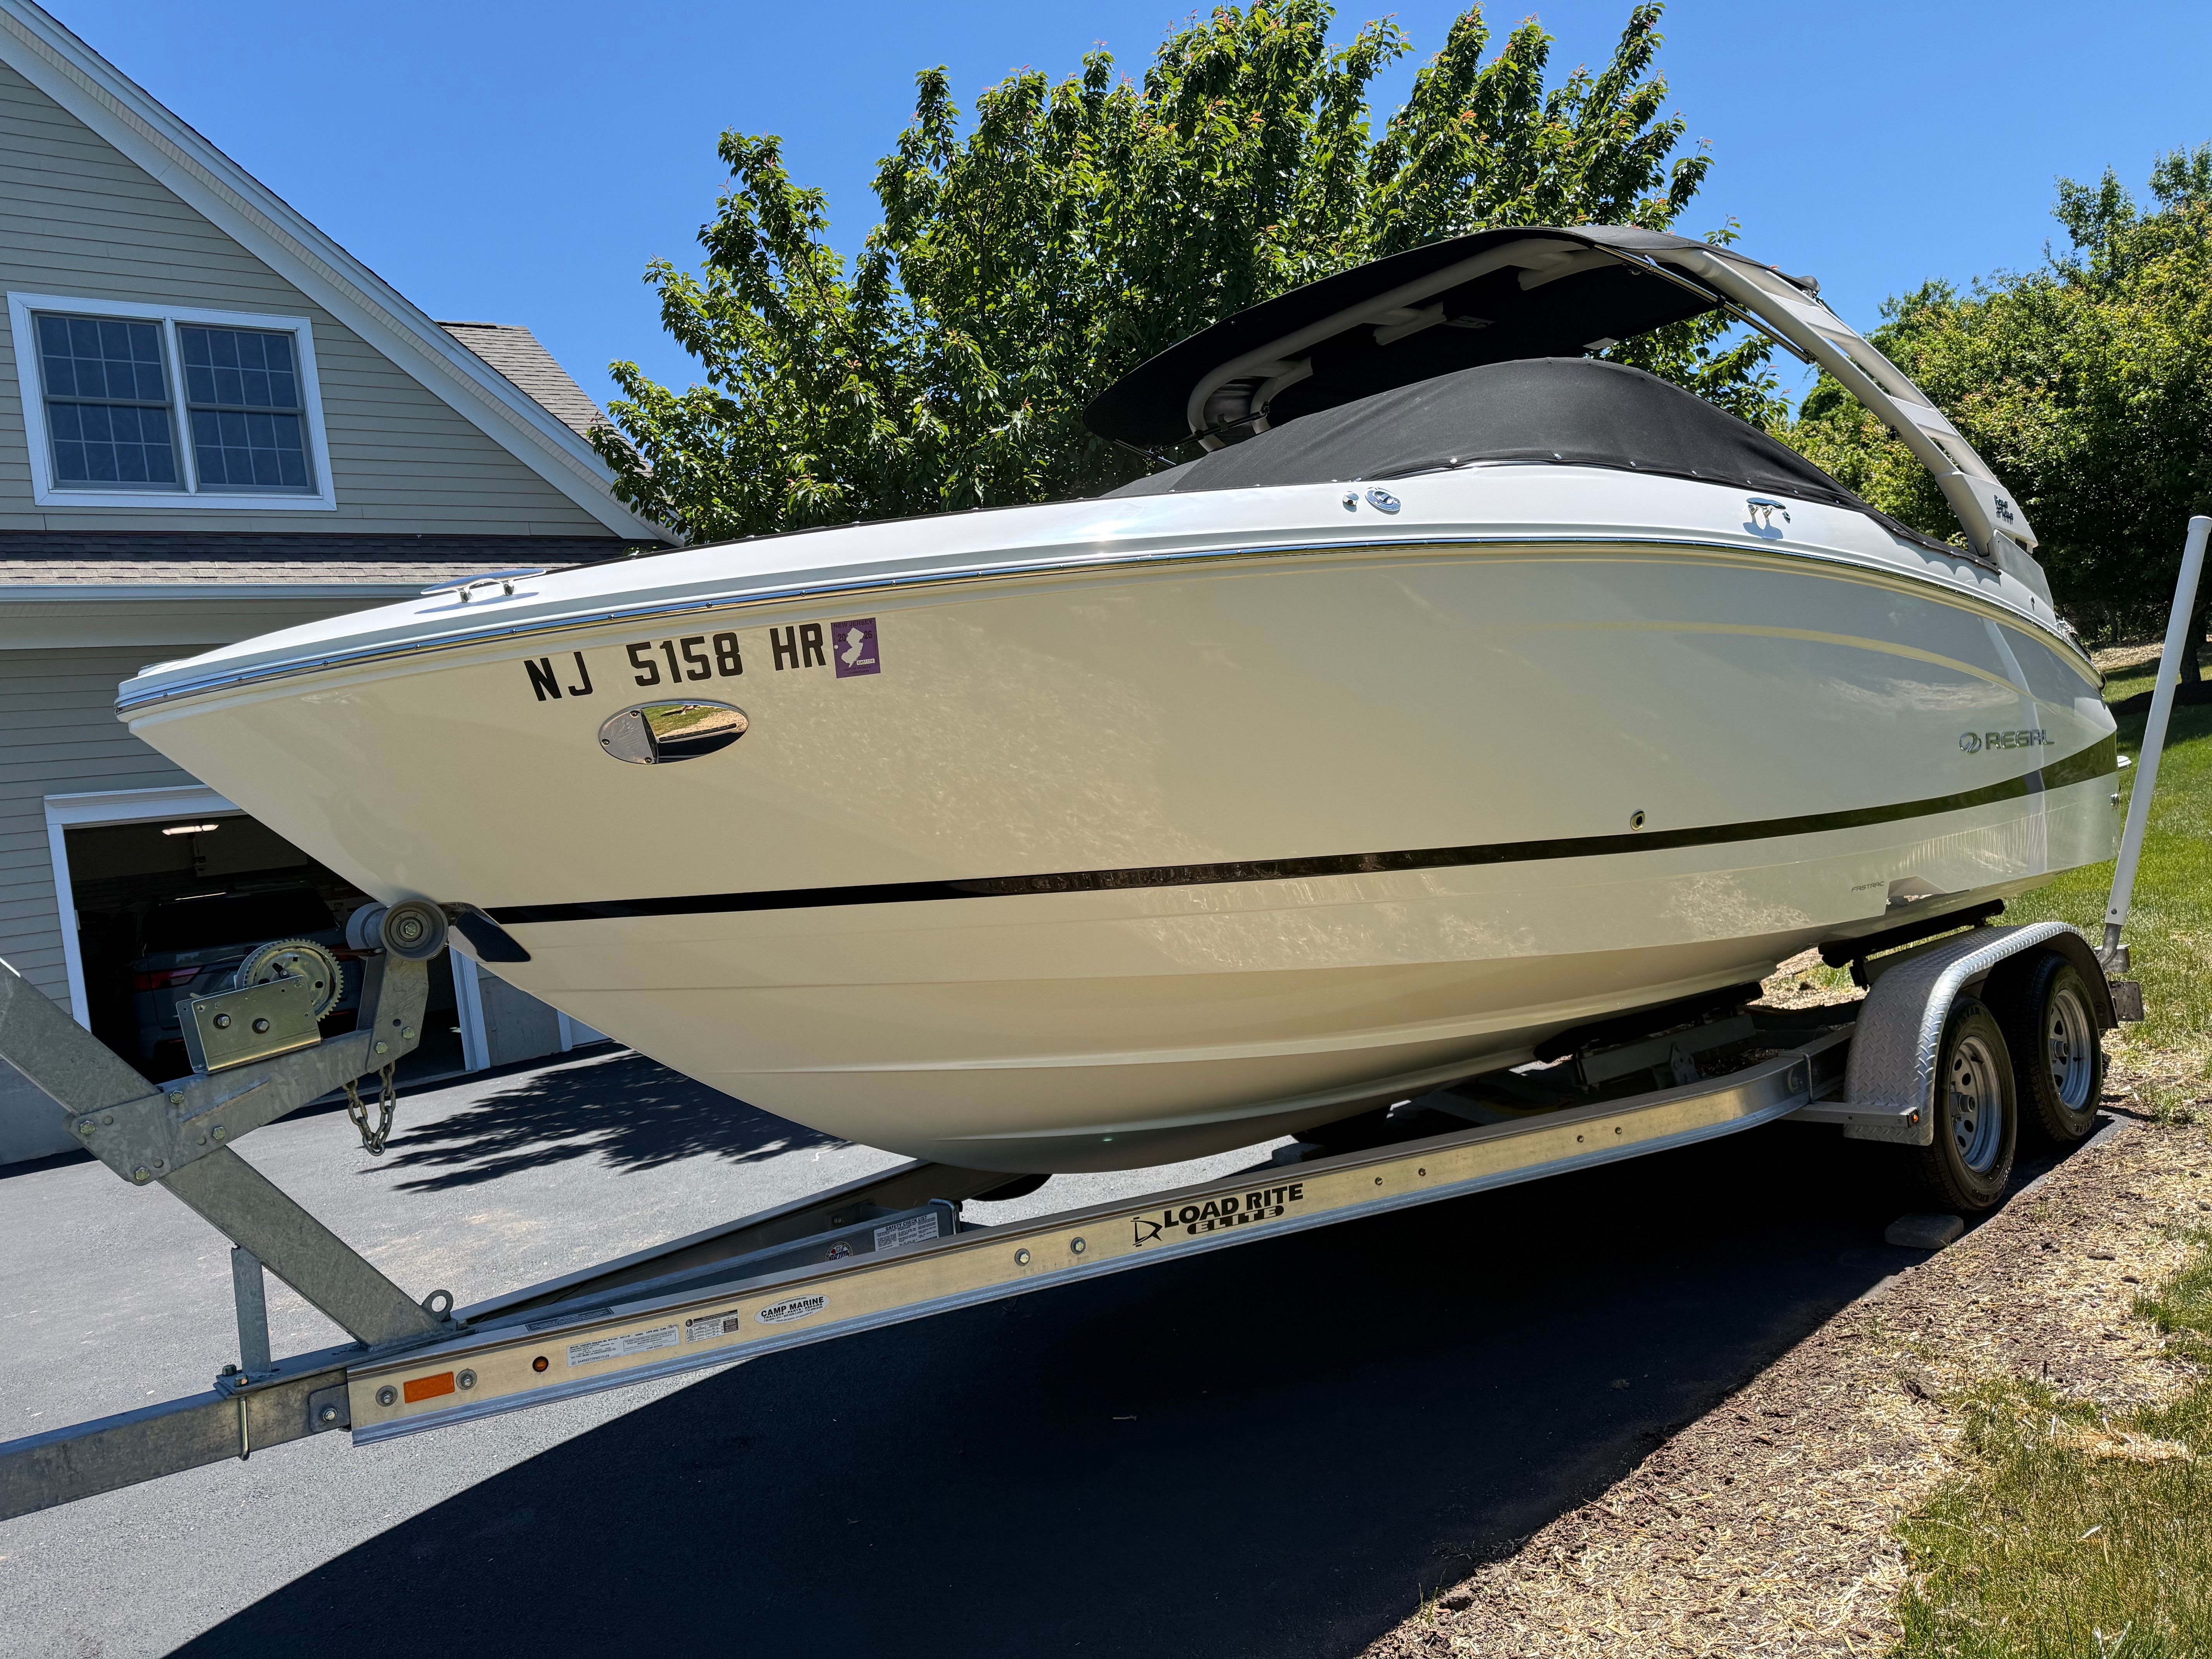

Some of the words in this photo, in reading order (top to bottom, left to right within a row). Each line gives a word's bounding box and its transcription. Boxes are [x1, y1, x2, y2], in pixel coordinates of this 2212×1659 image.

[838, 633, 847, 642] 20
[864, 630, 872, 639] 26
[524, 651, 593, 701] NJ
[626, 632, 743, 687] 5158
[769, 623, 826, 671] HR
[1986, 729, 2055, 750] REGAL
[1851, 881, 1884, 892] FASTRAC
[1164, 1197, 1239, 1228] LOAD
[1246, 1183, 1303, 1210] RITE
[886, 1223, 902, 1231] SAFETY
[903, 1218, 917, 1226] CHECK
[1195, 1207, 1277, 1234] ELITE
[761, 1305, 787, 1317] CAMP
[789, 1296, 824, 1310] MARINE
